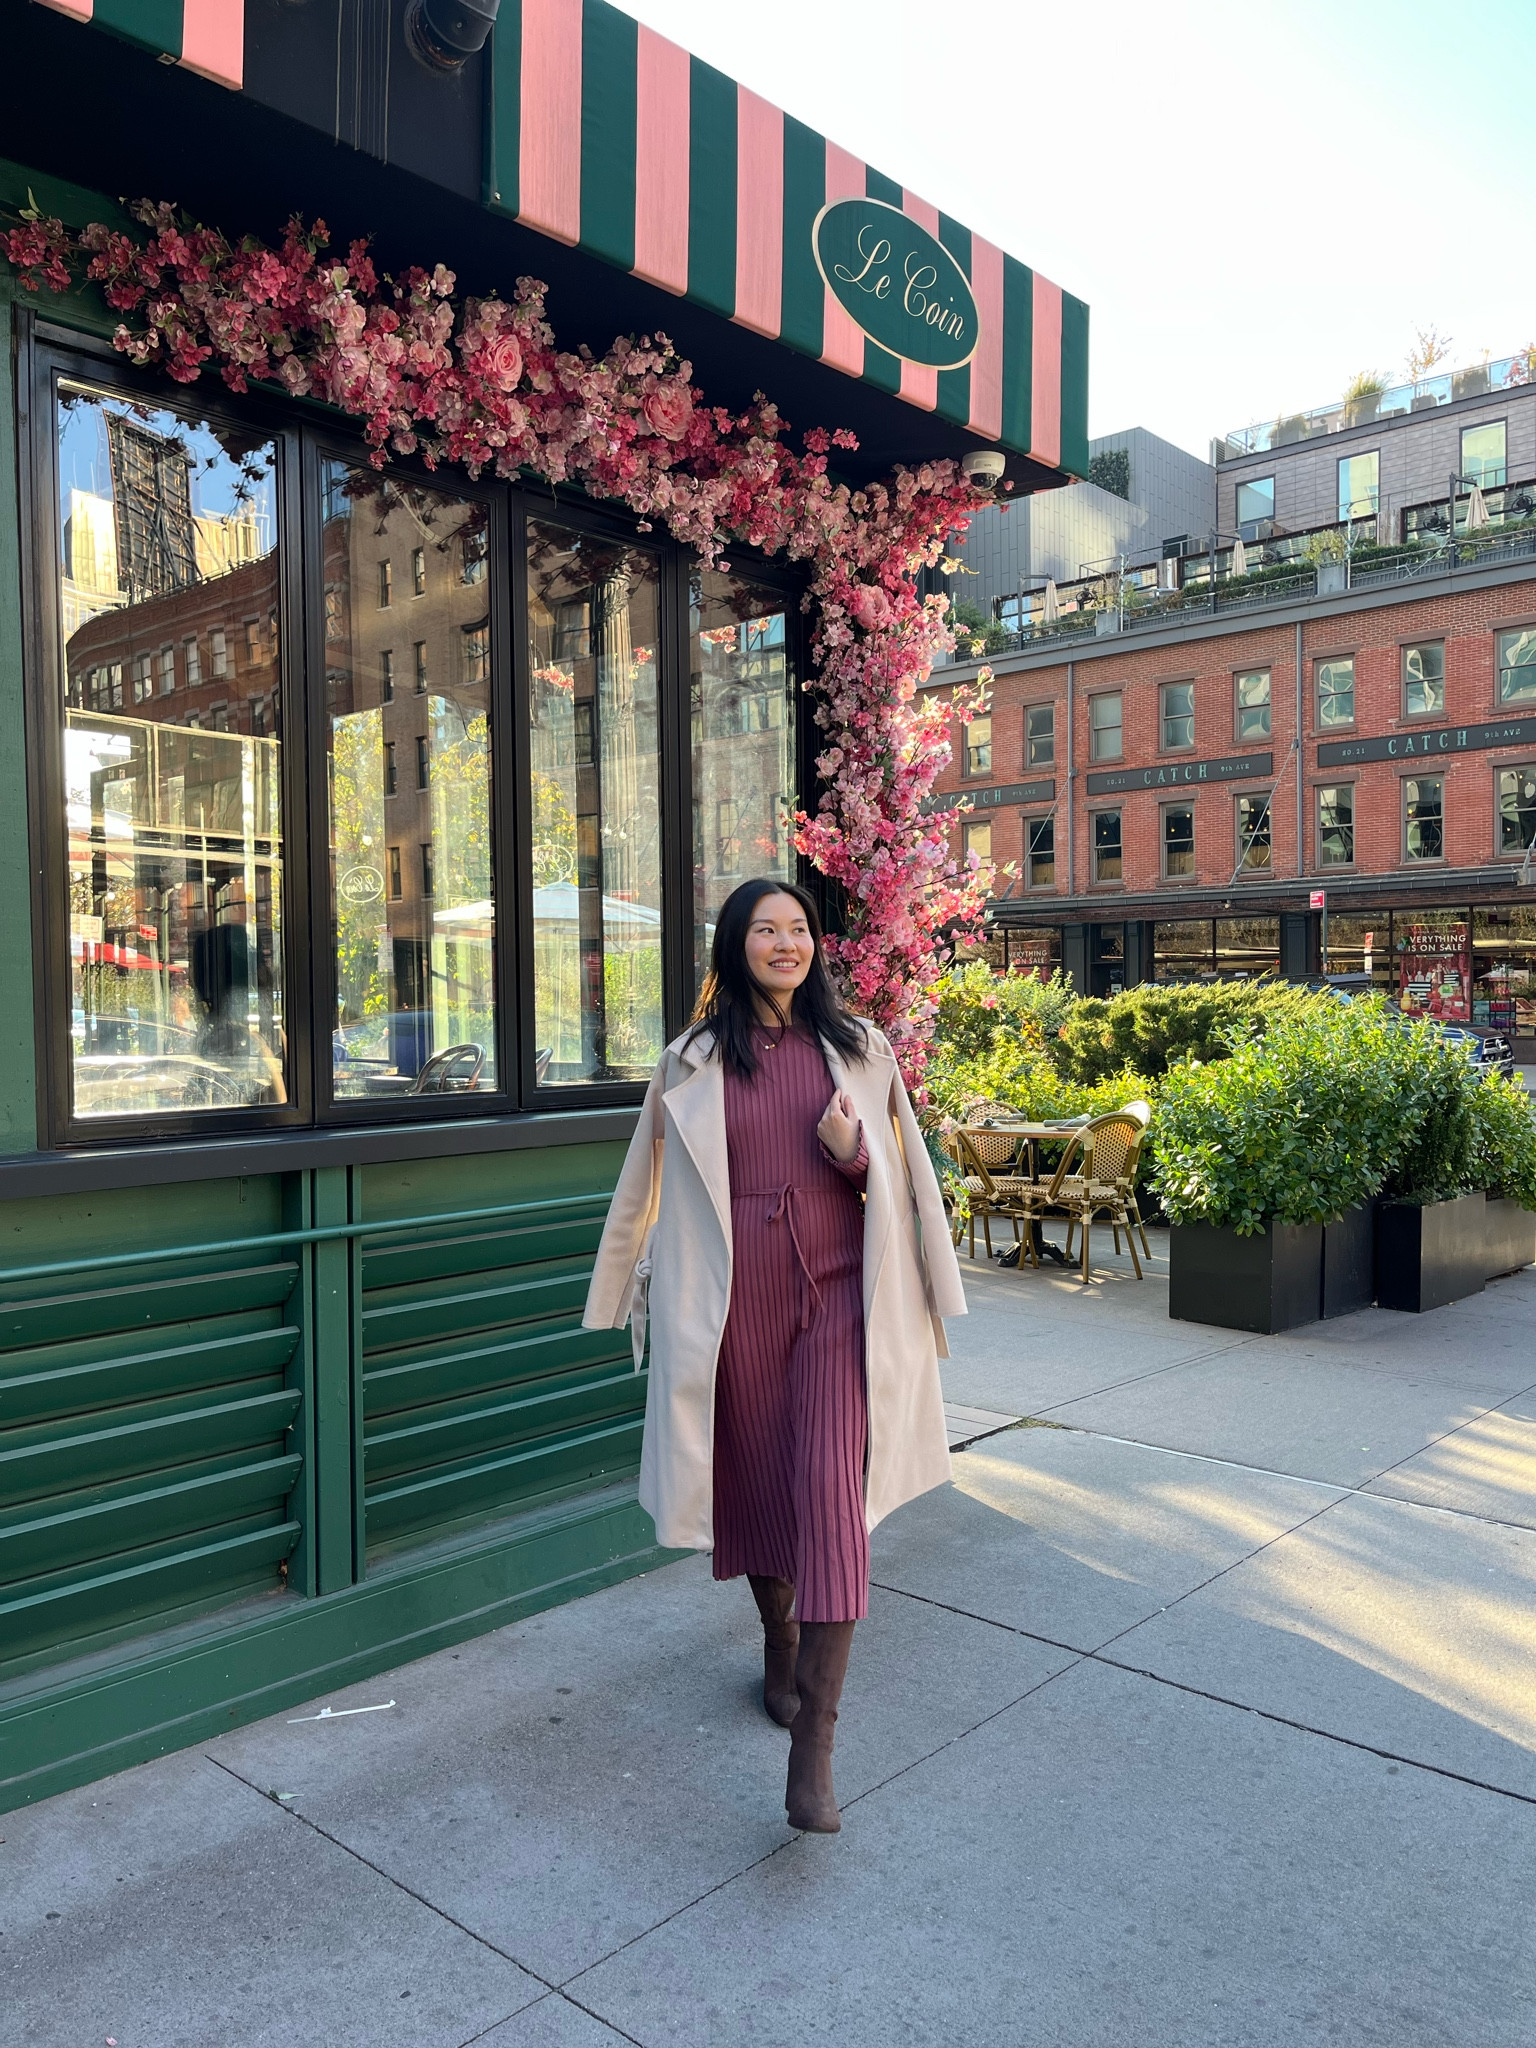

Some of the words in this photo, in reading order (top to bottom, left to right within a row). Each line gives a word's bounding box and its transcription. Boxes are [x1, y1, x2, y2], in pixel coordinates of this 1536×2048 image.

[834, 224, 891, 299] Le
[904, 251, 964, 341] Coin
[1387, 730, 1468, 755] CATCH
[1503, 728, 1521, 737] AVE
[1143, 763, 1208, 785] CATCH
[1410, 935, 1467, 943] VERYTHING
[1008, 950, 1048, 958] VERYTHING
